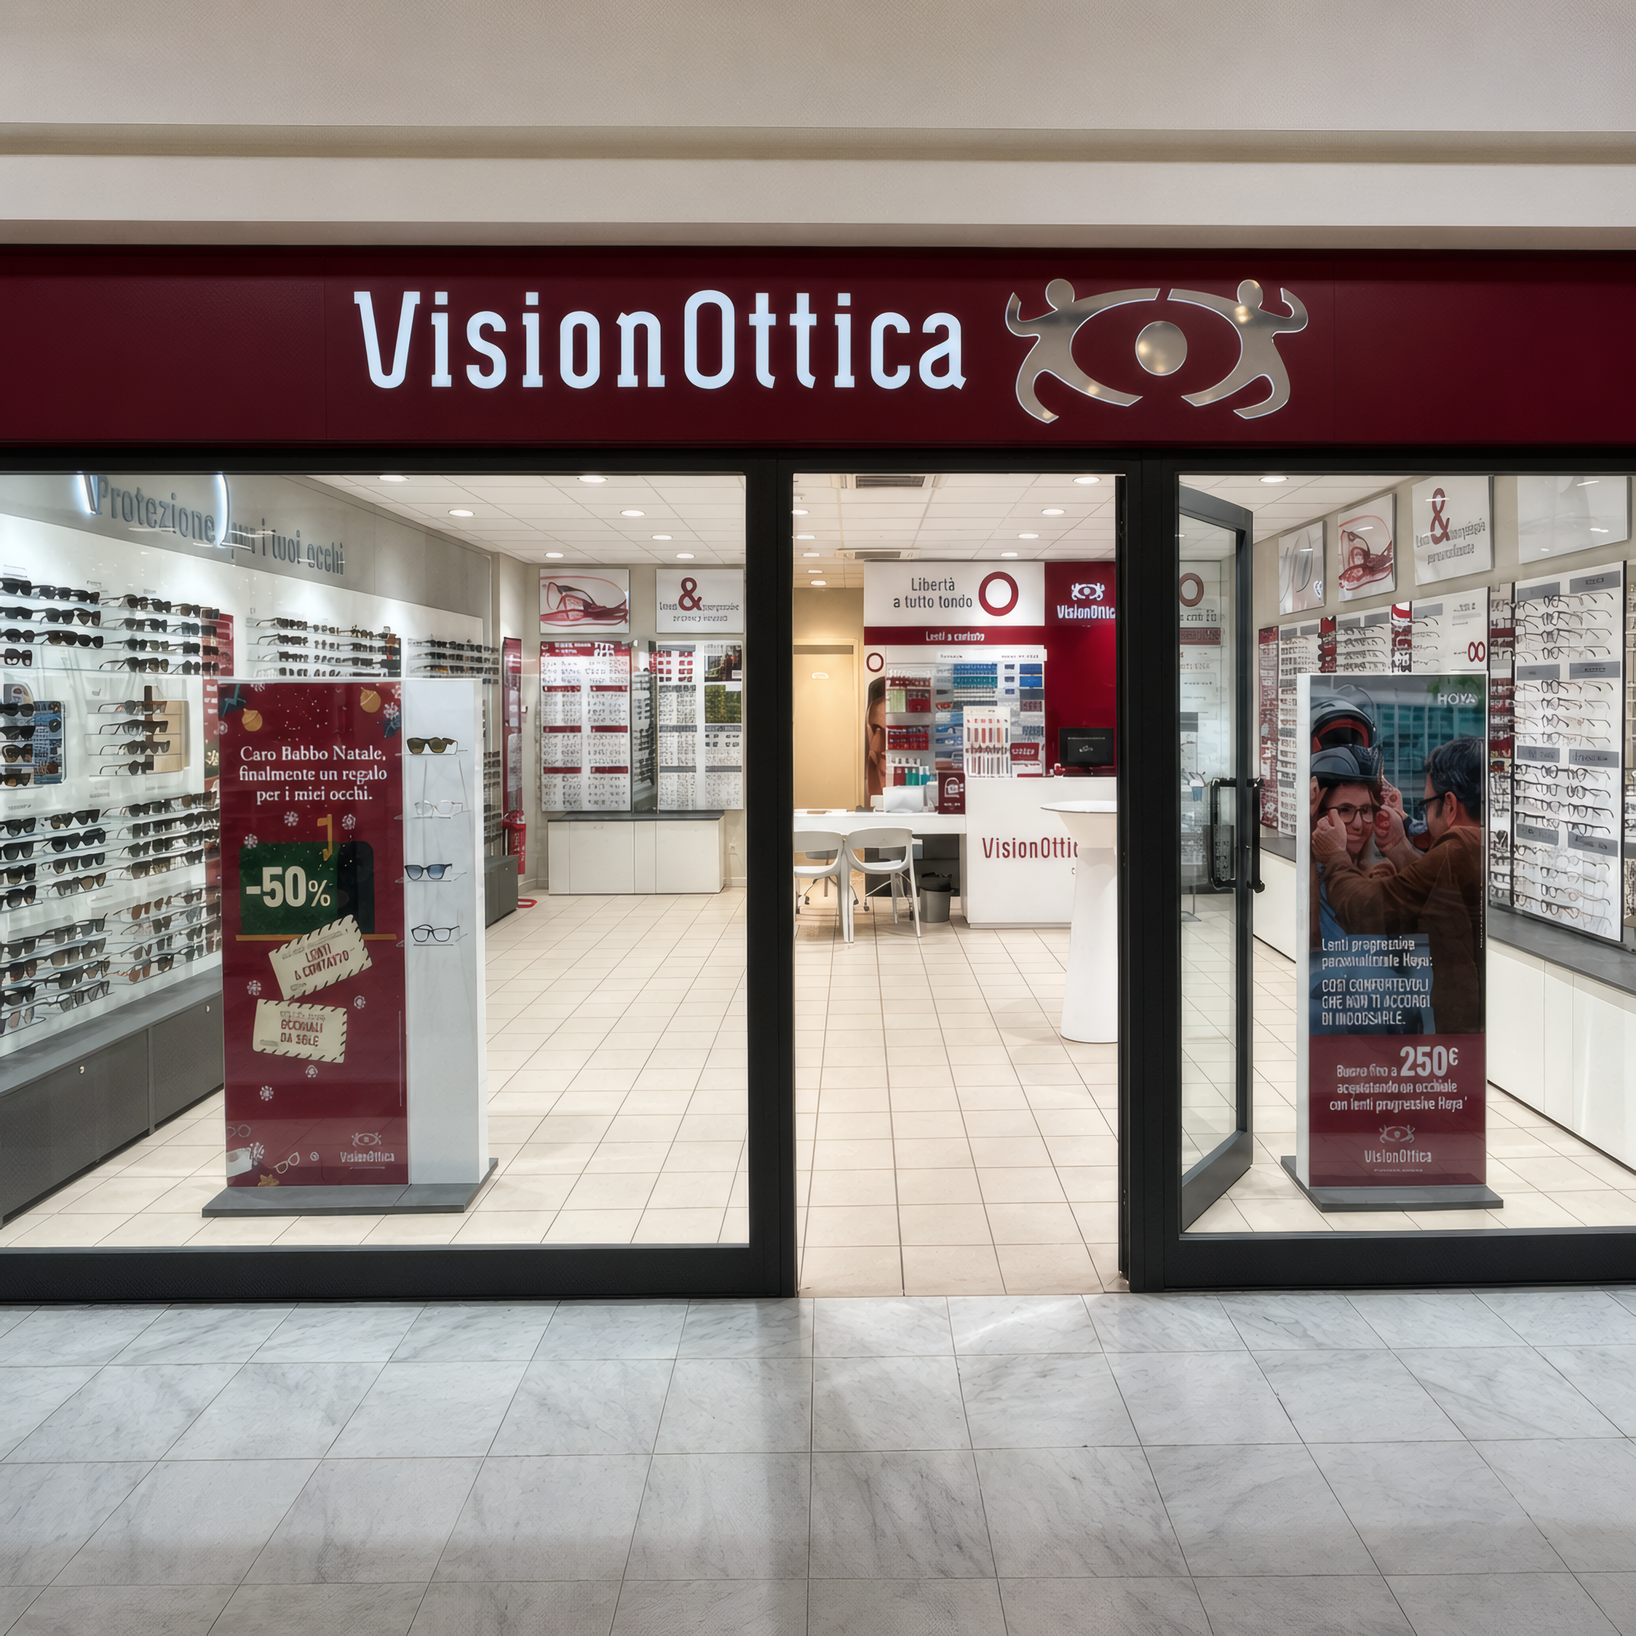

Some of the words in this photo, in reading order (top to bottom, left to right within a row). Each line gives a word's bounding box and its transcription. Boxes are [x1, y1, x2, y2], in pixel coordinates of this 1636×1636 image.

[353, 289, 967, 390] VisionOttica
[911, 576, 956, 592] Libertà
[893, 597, 901, 609] a
[904, 594, 935, 609] tutto
[240, 745, 277, 762] Caro
[281, 744, 329, 761] Babbo
[332, 744, 387, 762] Natale,
[239, 764, 316, 782] finalmente
[319, 770, 338, 781] un
[342, 764, 388, 786] regalo
[256, 790, 281, 806] per
[285, 786, 290, 801] i
[329, 785, 373, 801] occhi.
[982, 837, 1078, 859] VisionOtti
[246, 865, 331, 908] -50%
[1390, 1066, 1397, 1077] a
[1399, 1045, 1459, 1077] 250€
